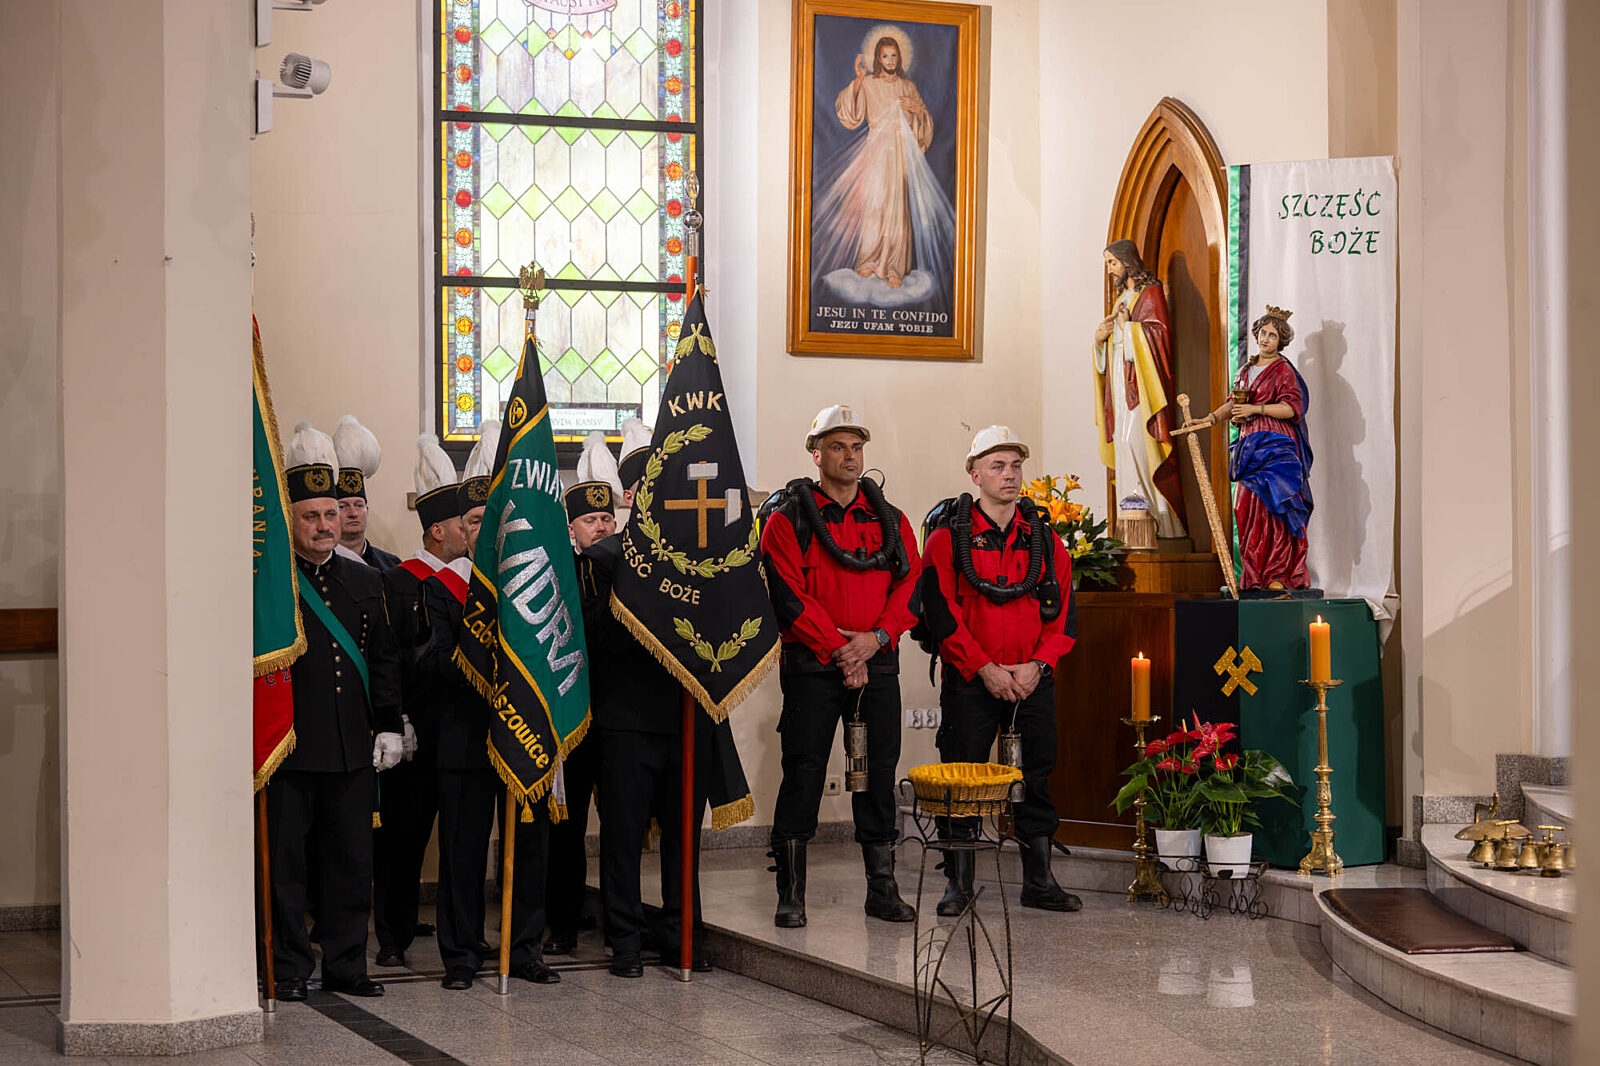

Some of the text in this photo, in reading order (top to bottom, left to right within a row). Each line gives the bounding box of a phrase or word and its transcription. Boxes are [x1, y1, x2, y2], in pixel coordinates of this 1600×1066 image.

[1310, 227, 1380, 255] BOŻE
[816, 306, 948, 323] JESU IN TE CONFIDO
[830, 320, 934, 333] JEZU UFAM TOBIE
[668, 390, 723, 417] KWK
[496, 499, 585, 697] KADRA
[658, 577, 700, 605] BOŻE
